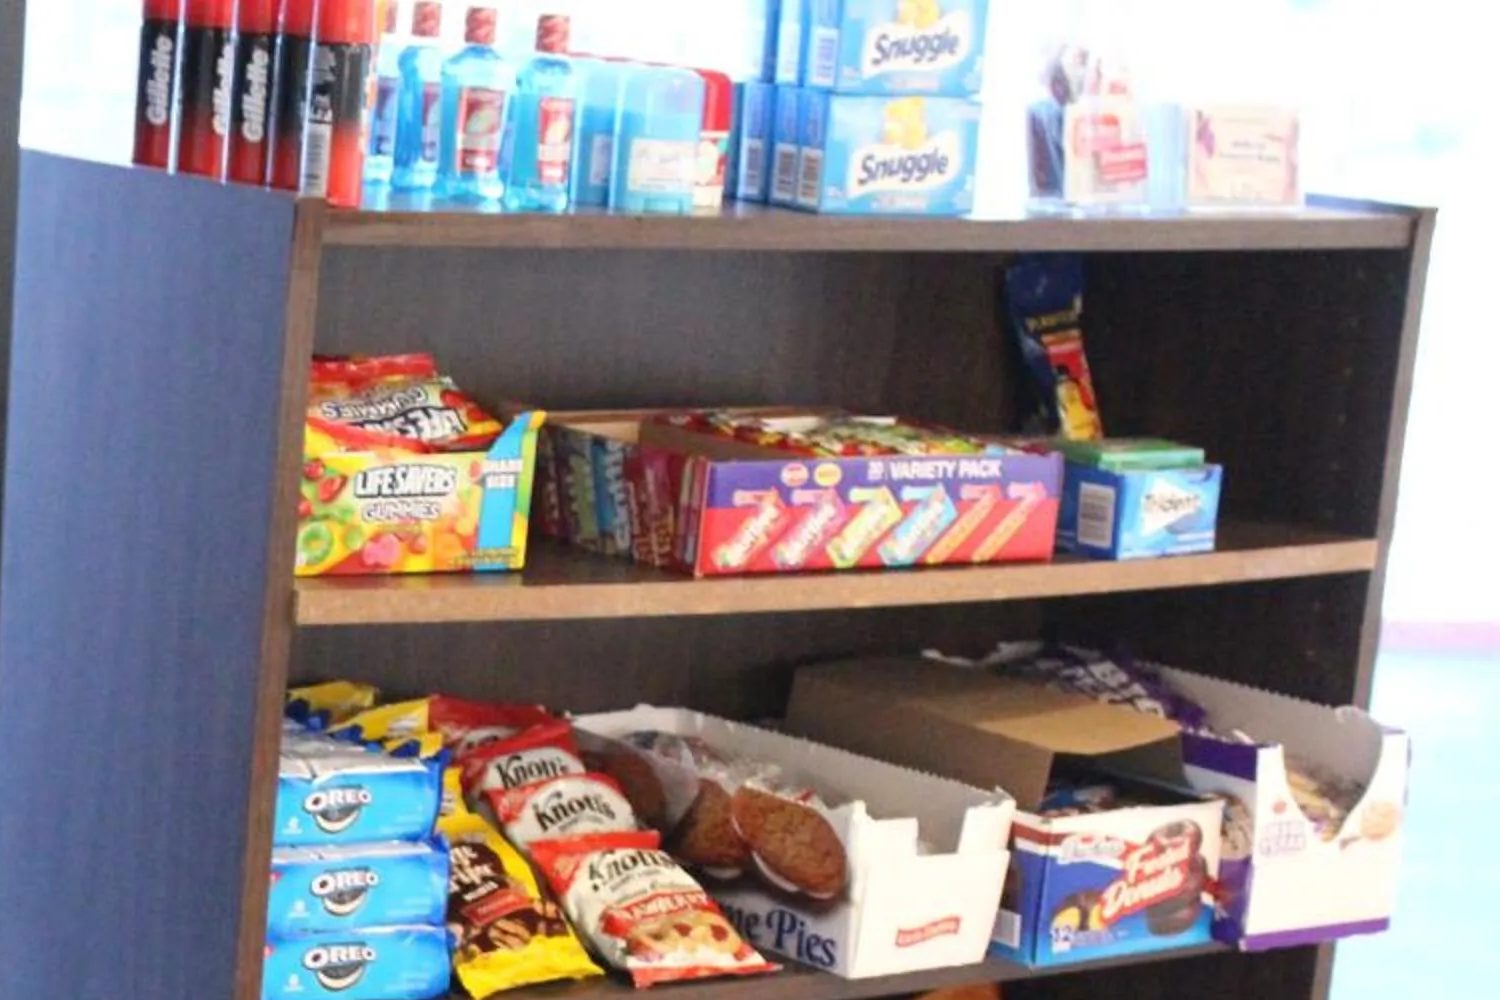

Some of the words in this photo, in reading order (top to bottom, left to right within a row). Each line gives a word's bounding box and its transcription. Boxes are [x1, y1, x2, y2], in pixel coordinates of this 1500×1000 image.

[870, 28, 959, 66] Snuggle
[241, 47, 269, 143] Gillette
[857, 149, 949, 186] Snuggle
[890, 460, 957, 480] VARIETY
[959, 459, 1001, 479] PACK
[303, 786, 372, 813] OREO
[310, 867, 379, 896] OREO
[766, 908, 838, 968] Pies
[303, 944, 376, 970] OREO
